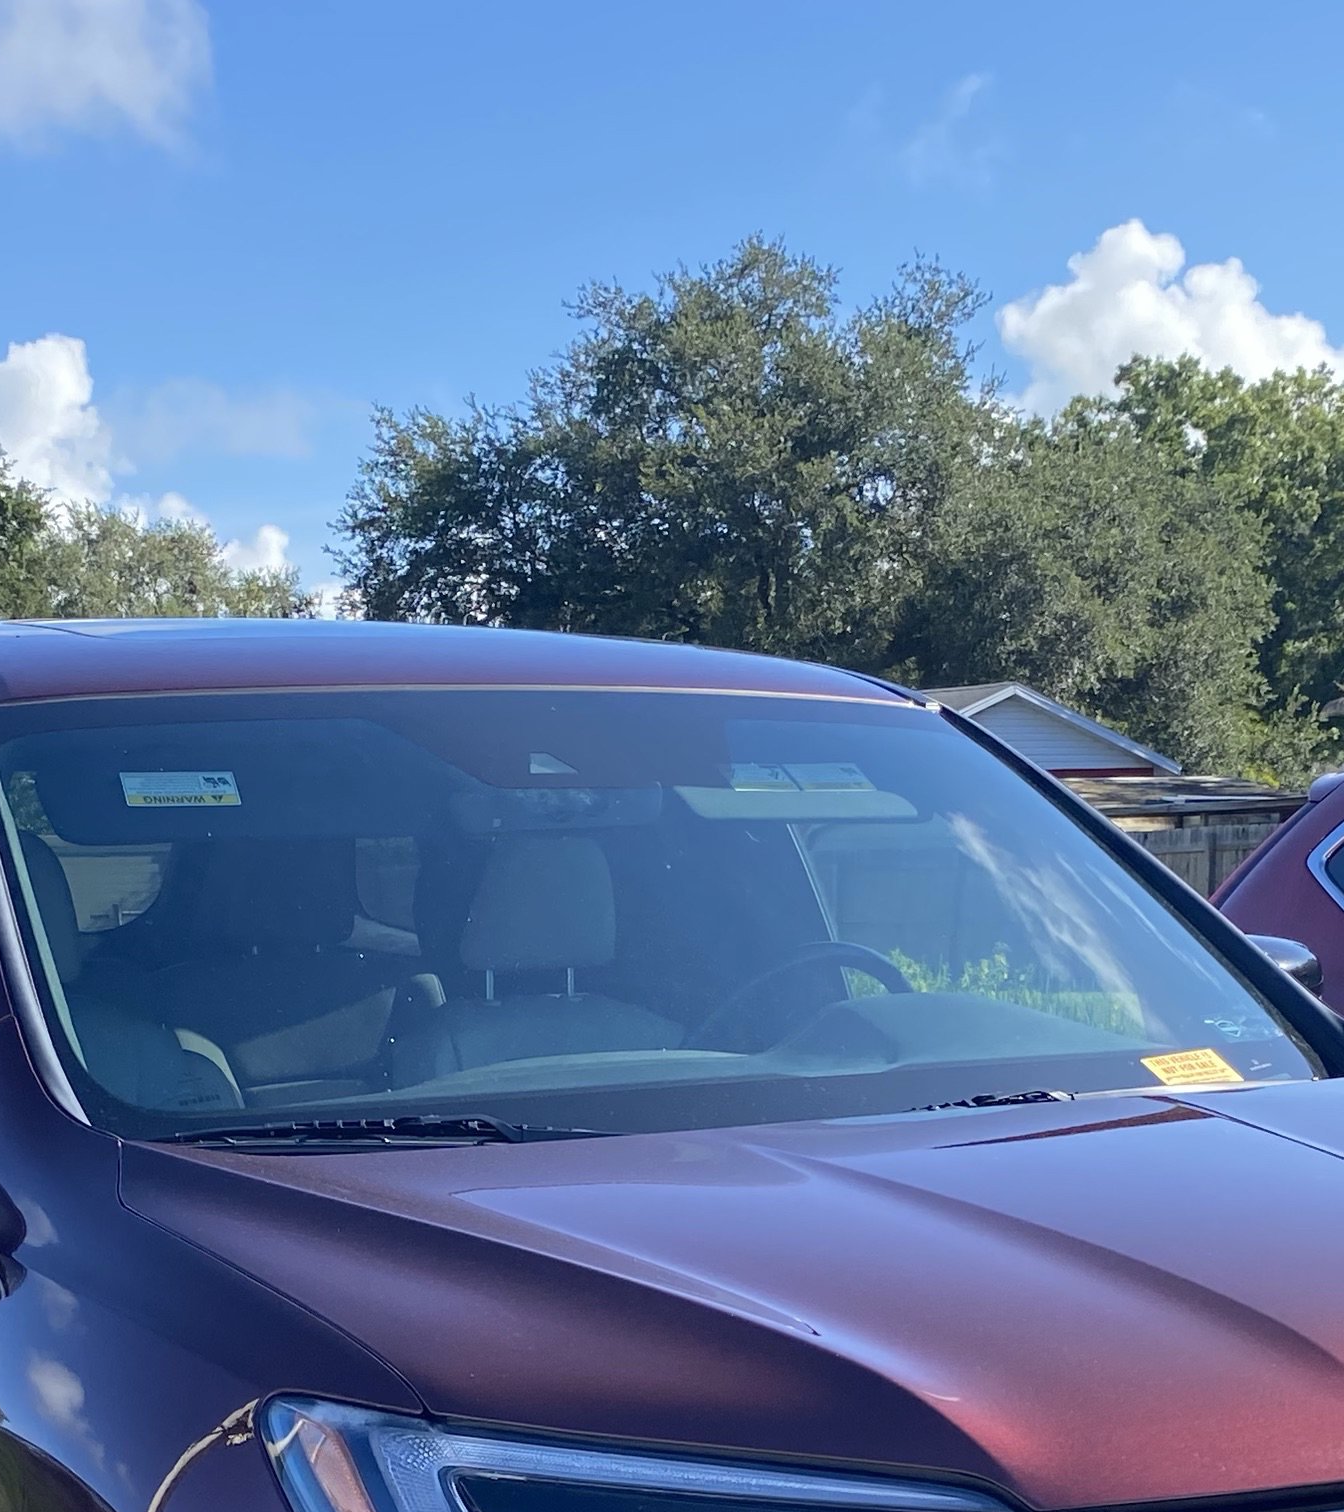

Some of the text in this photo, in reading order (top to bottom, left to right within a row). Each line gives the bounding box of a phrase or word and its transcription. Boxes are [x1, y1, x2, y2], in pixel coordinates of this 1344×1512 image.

[143, 795, 206, 804] WARNING
[1149, 1057, 1169, 1067] THIS
[1170, 1053, 1201, 1063] VEHICLE
[1161, 1060, 1217, 1074] NOT FOR SALE
